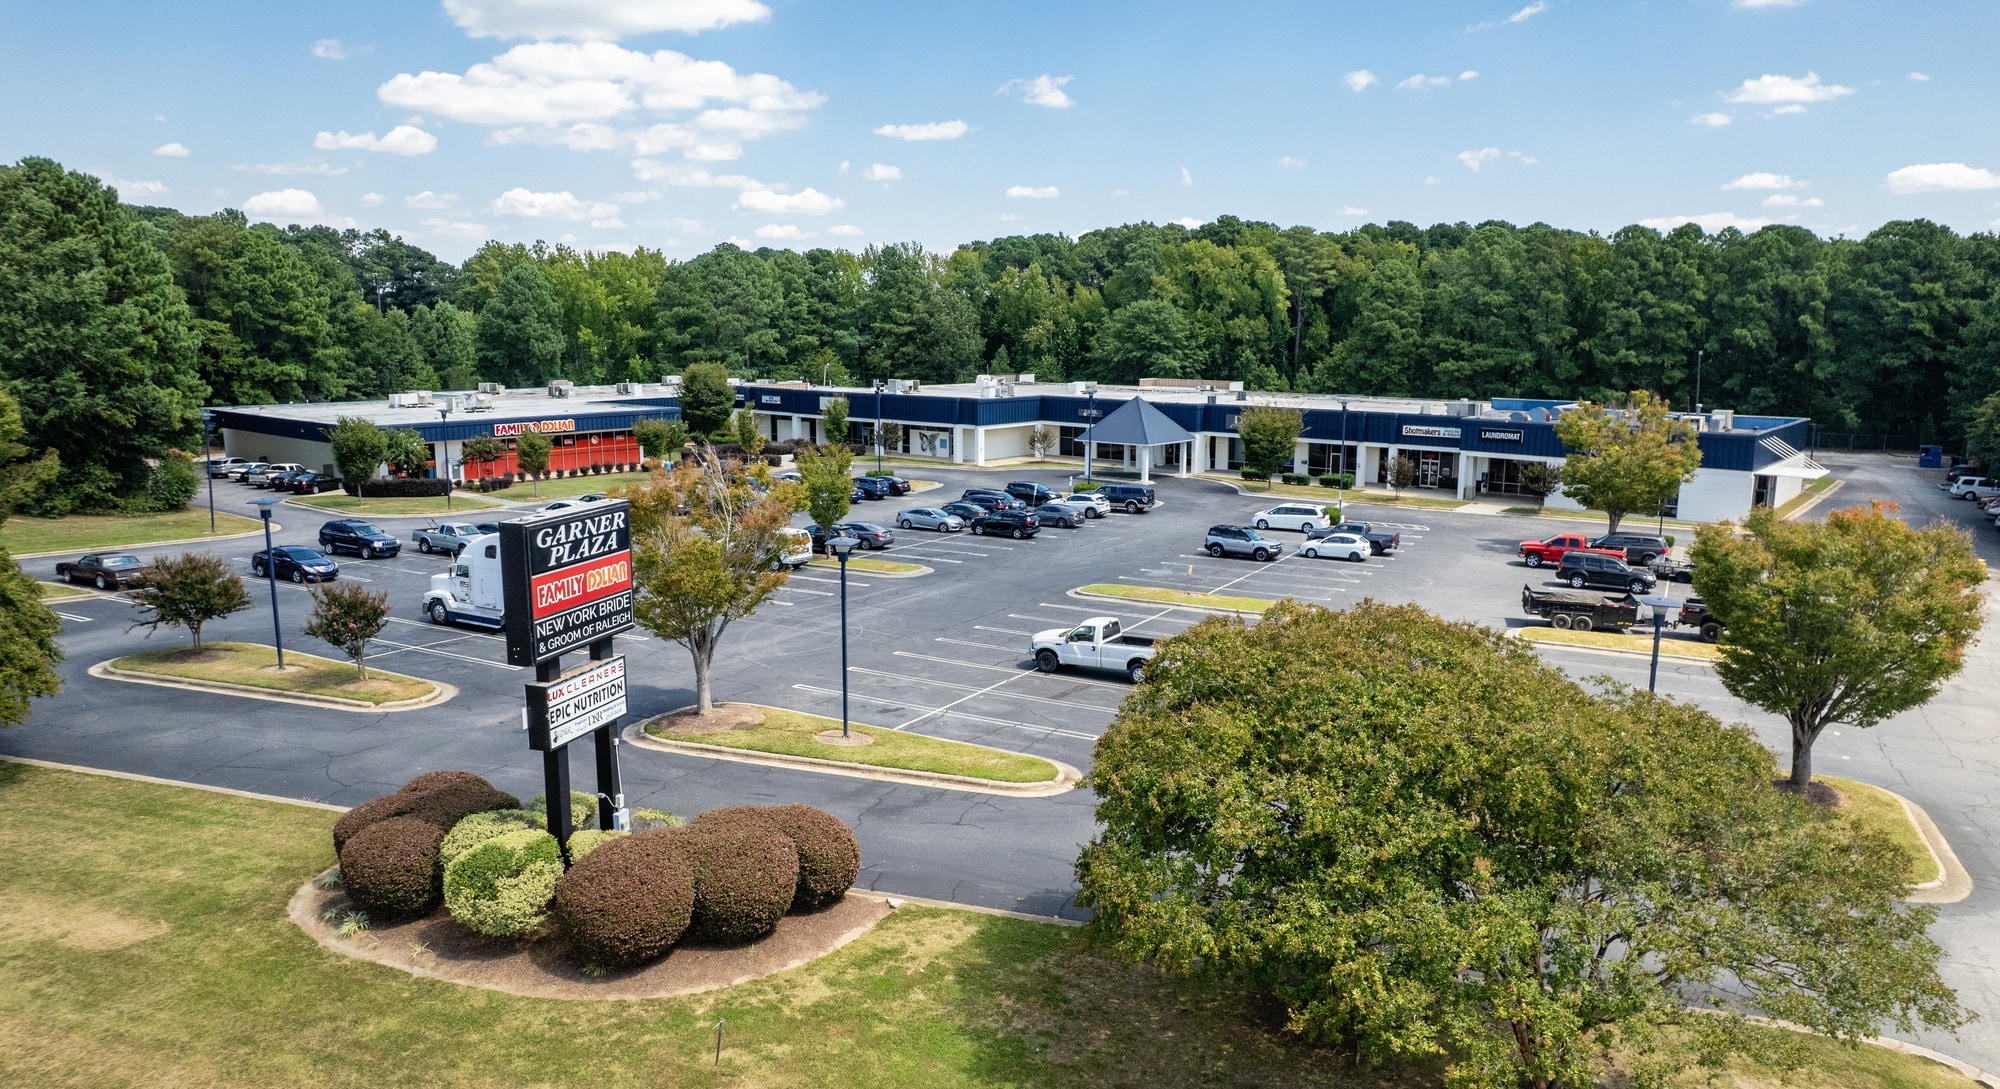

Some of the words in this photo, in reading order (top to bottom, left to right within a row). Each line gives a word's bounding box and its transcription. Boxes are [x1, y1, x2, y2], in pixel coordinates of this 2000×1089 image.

[541, 419, 575, 432] DOLLAR
[1404, 426, 1441, 436] Shotmakers
[1481, 431, 1521, 440] LAUNDROMAT
[536, 512, 625, 548] GARNER
[548, 531, 618, 567] PLAZA
[537, 573, 585, 608] FAMILY
[586, 561, 628, 592] DOLLAR
[536, 615, 566, 639] NEW
[566, 605, 598, 627] YORK
[599, 594, 631, 616] BRIDE
[539, 642, 547, 653] &
[547, 628, 582, 650] GROOM
[582, 623, 595, 637] OF
[595, 610, 631, 632] RALEIGH
[547, 687, 565, 703] LUX
[566, 663, 624, 693] CLEANERS
[549, 703, 571, 725] EPIC
[574, 680, 623, 713] NUTRITION
